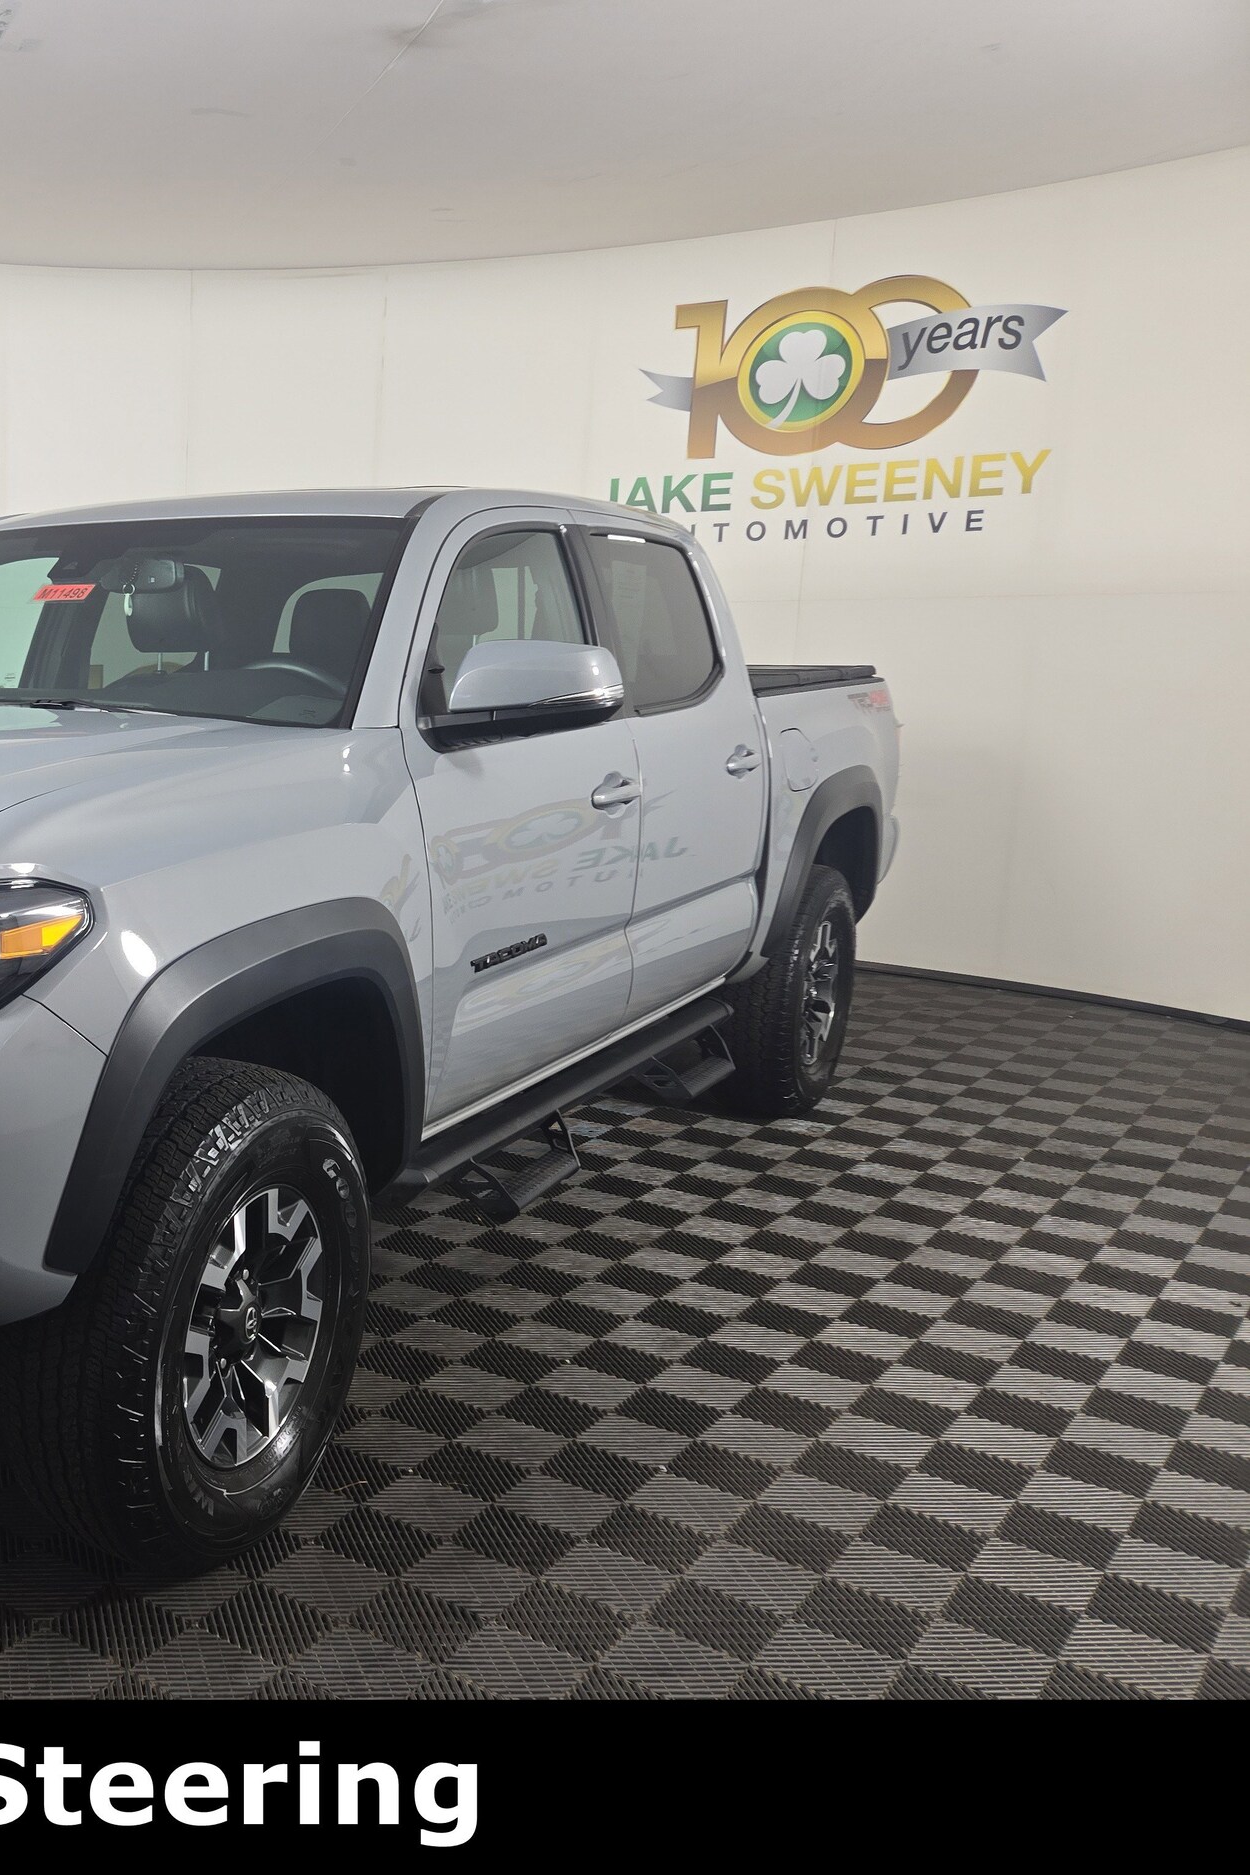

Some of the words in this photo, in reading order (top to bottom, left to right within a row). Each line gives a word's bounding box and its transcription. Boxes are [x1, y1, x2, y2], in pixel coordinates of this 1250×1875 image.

[675, 274, 980, 459] 100
[897, 313, 1026, 371] years
[750, 449, 1052, 511] SWEENEY
[690, 509, 985, 544] TOMOTIVE
[38, 587, 88, 599] M11498
